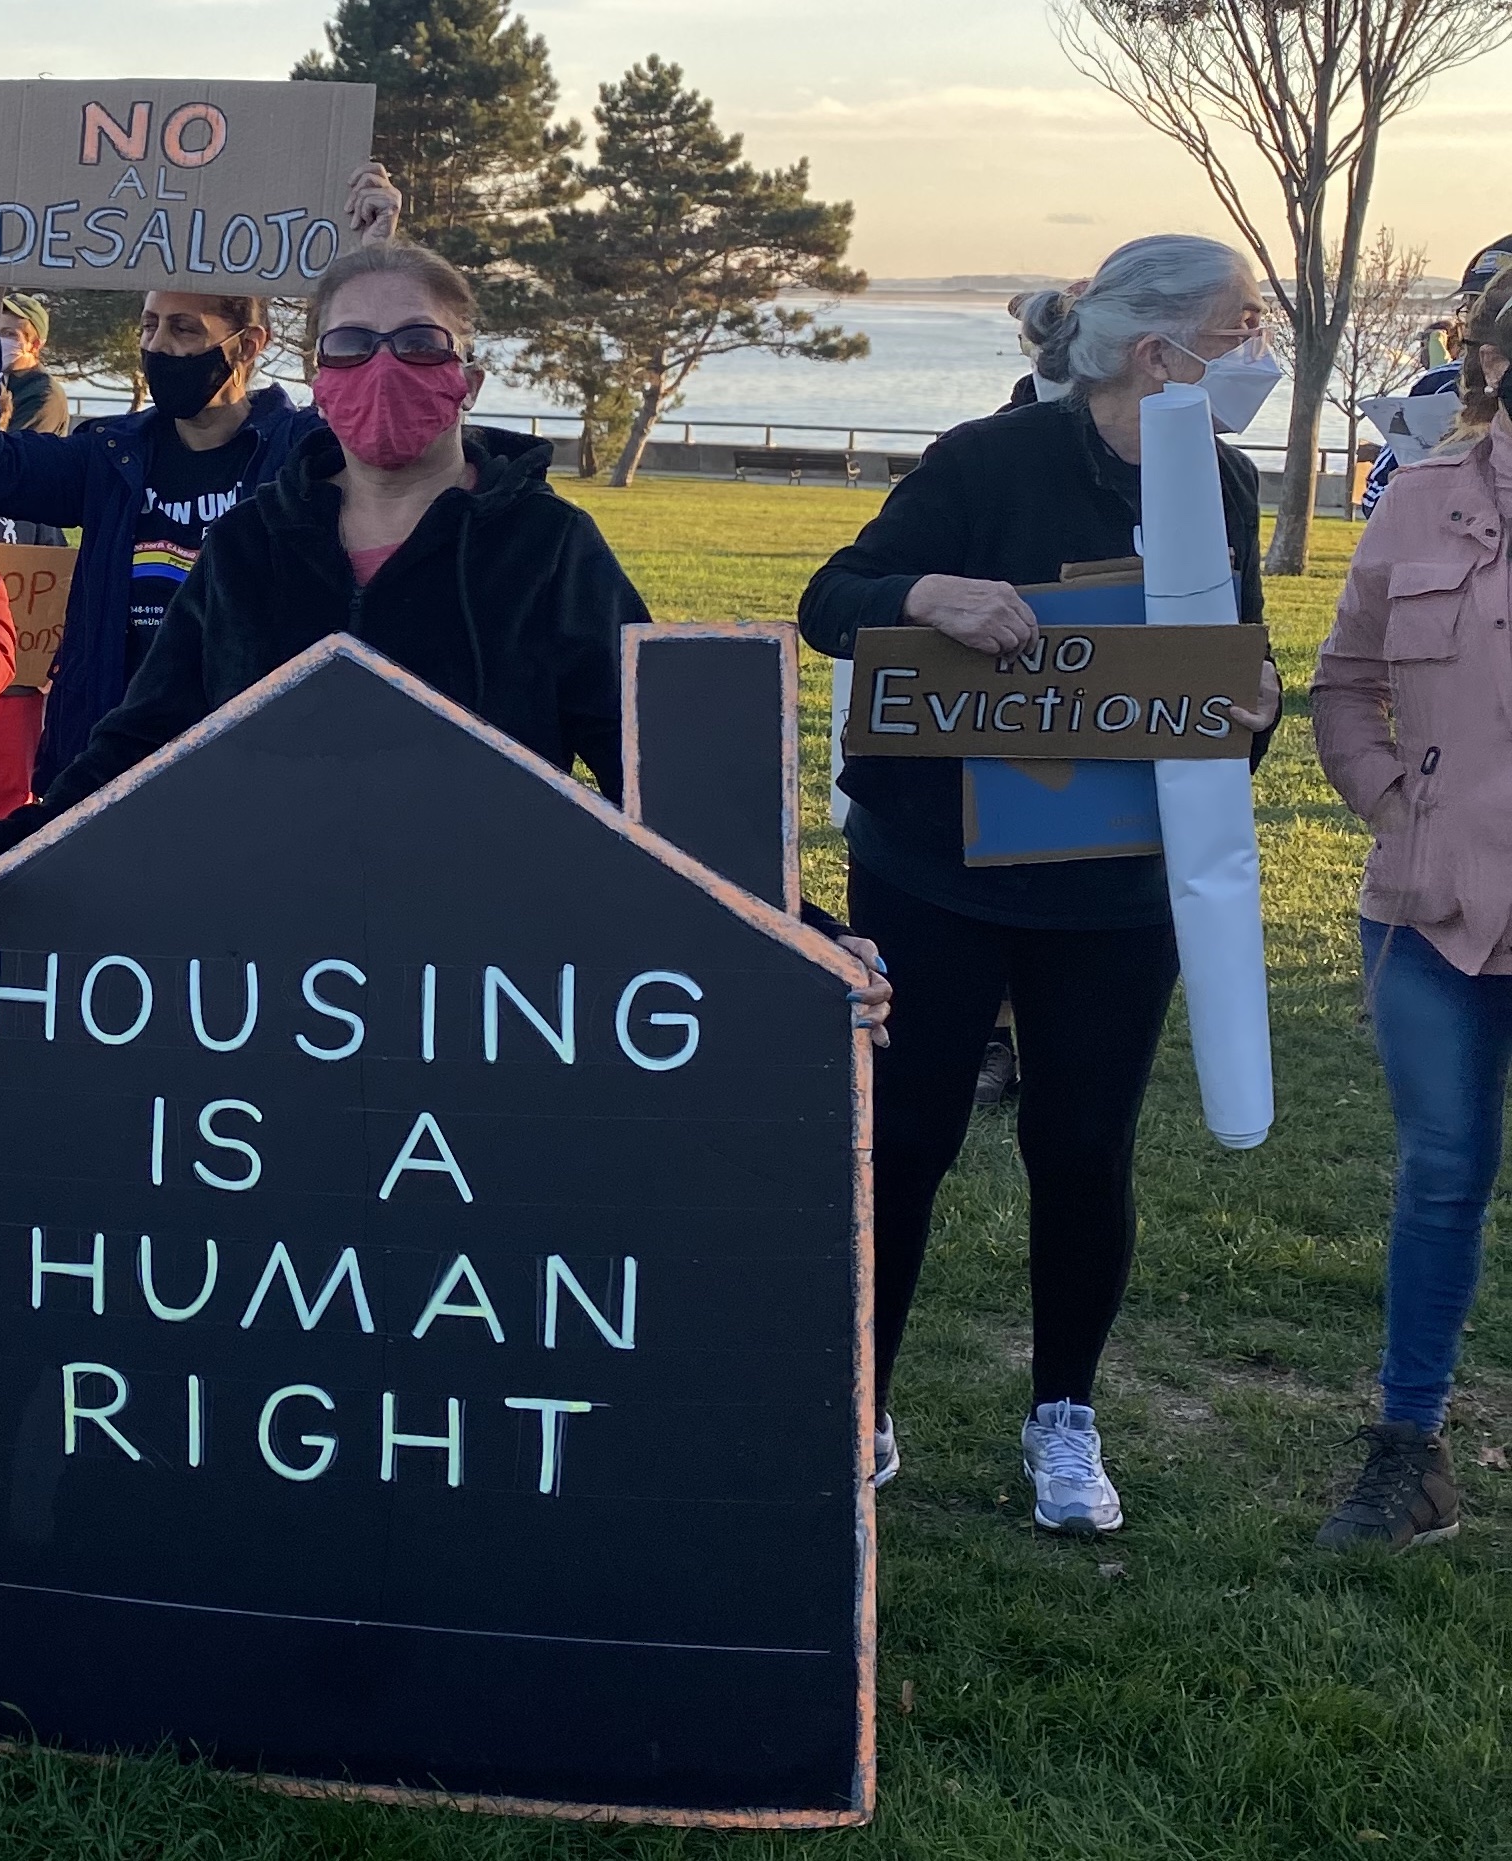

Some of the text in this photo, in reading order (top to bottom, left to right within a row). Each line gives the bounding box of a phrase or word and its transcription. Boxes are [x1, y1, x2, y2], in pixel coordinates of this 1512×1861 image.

[79, 101, 227, 169] NO
[109, 166, 187, 200] AL
[150, 1097, 474, 1203] IS A
[31, 1226, 639, 1350] HUMAN
[62, 1362, 594, 1494] RIGHT
